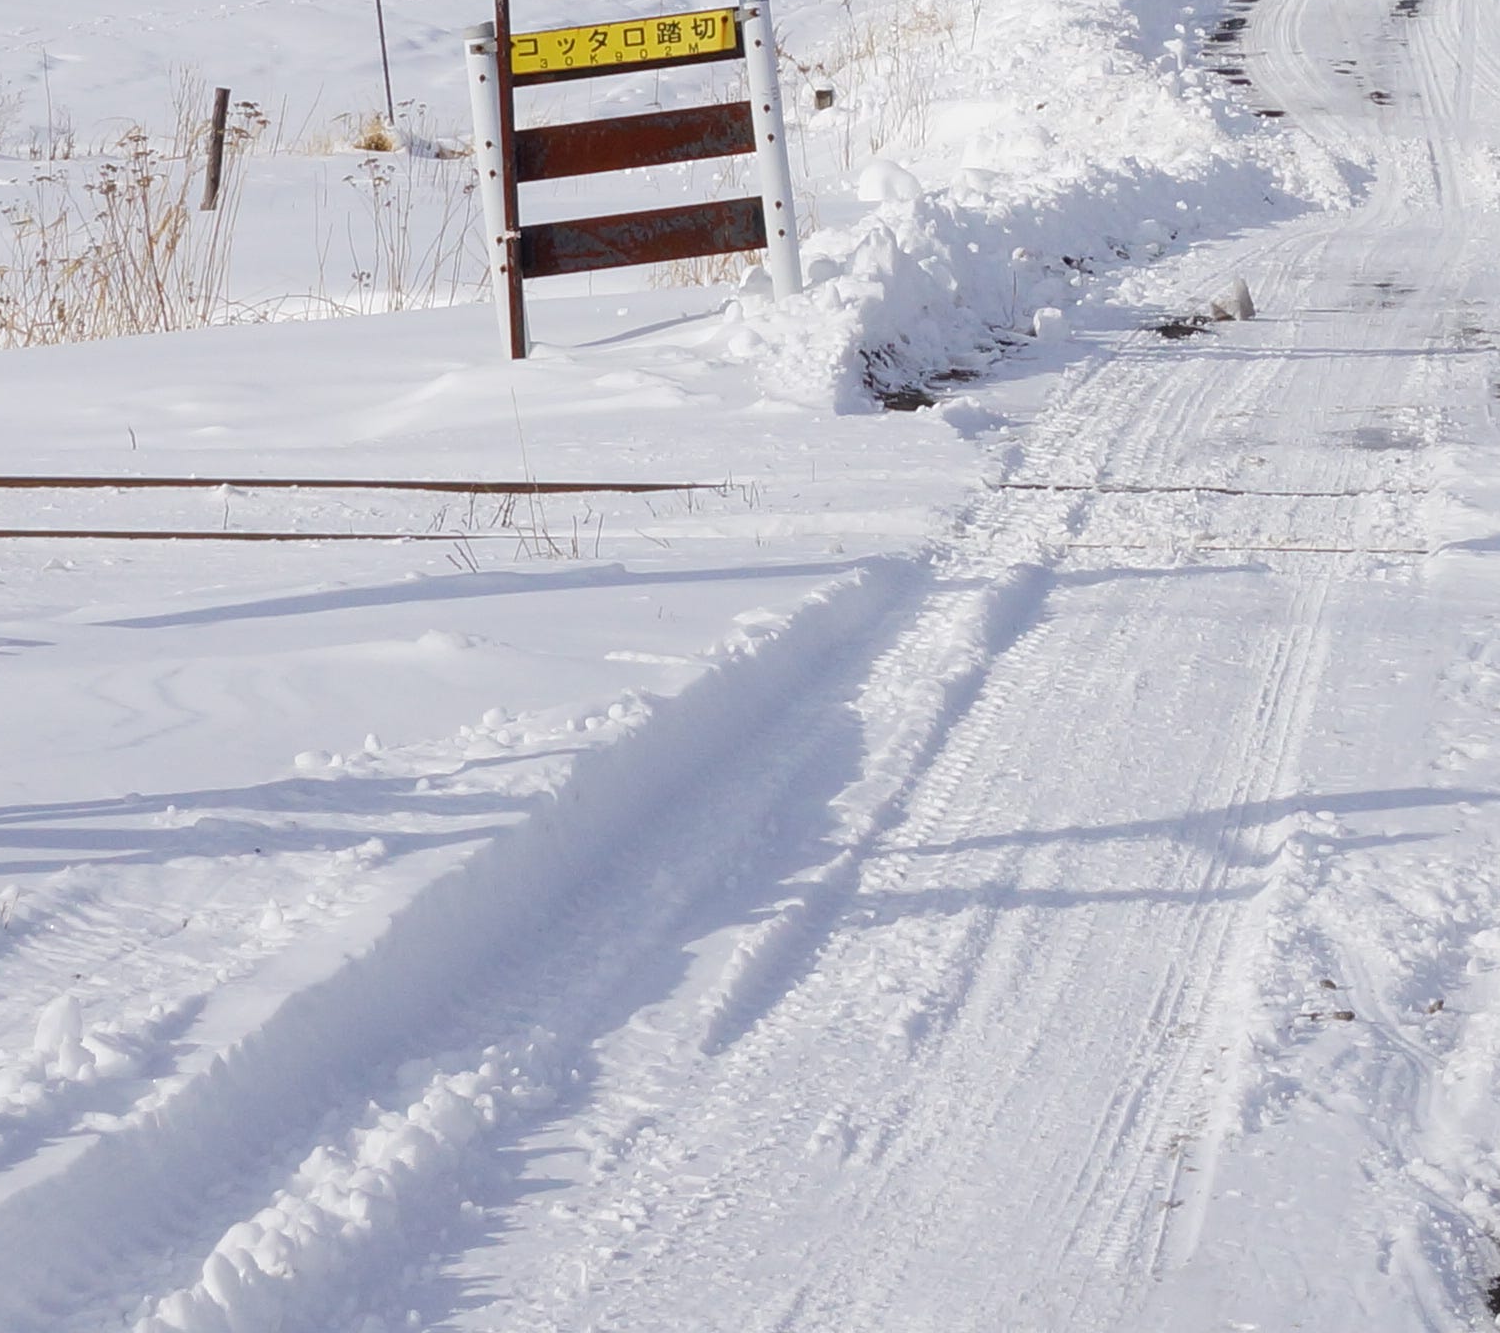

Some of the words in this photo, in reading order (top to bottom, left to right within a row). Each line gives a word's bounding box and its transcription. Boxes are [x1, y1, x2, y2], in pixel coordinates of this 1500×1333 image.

[516, 17, 716, 56] コッタロ踏切
